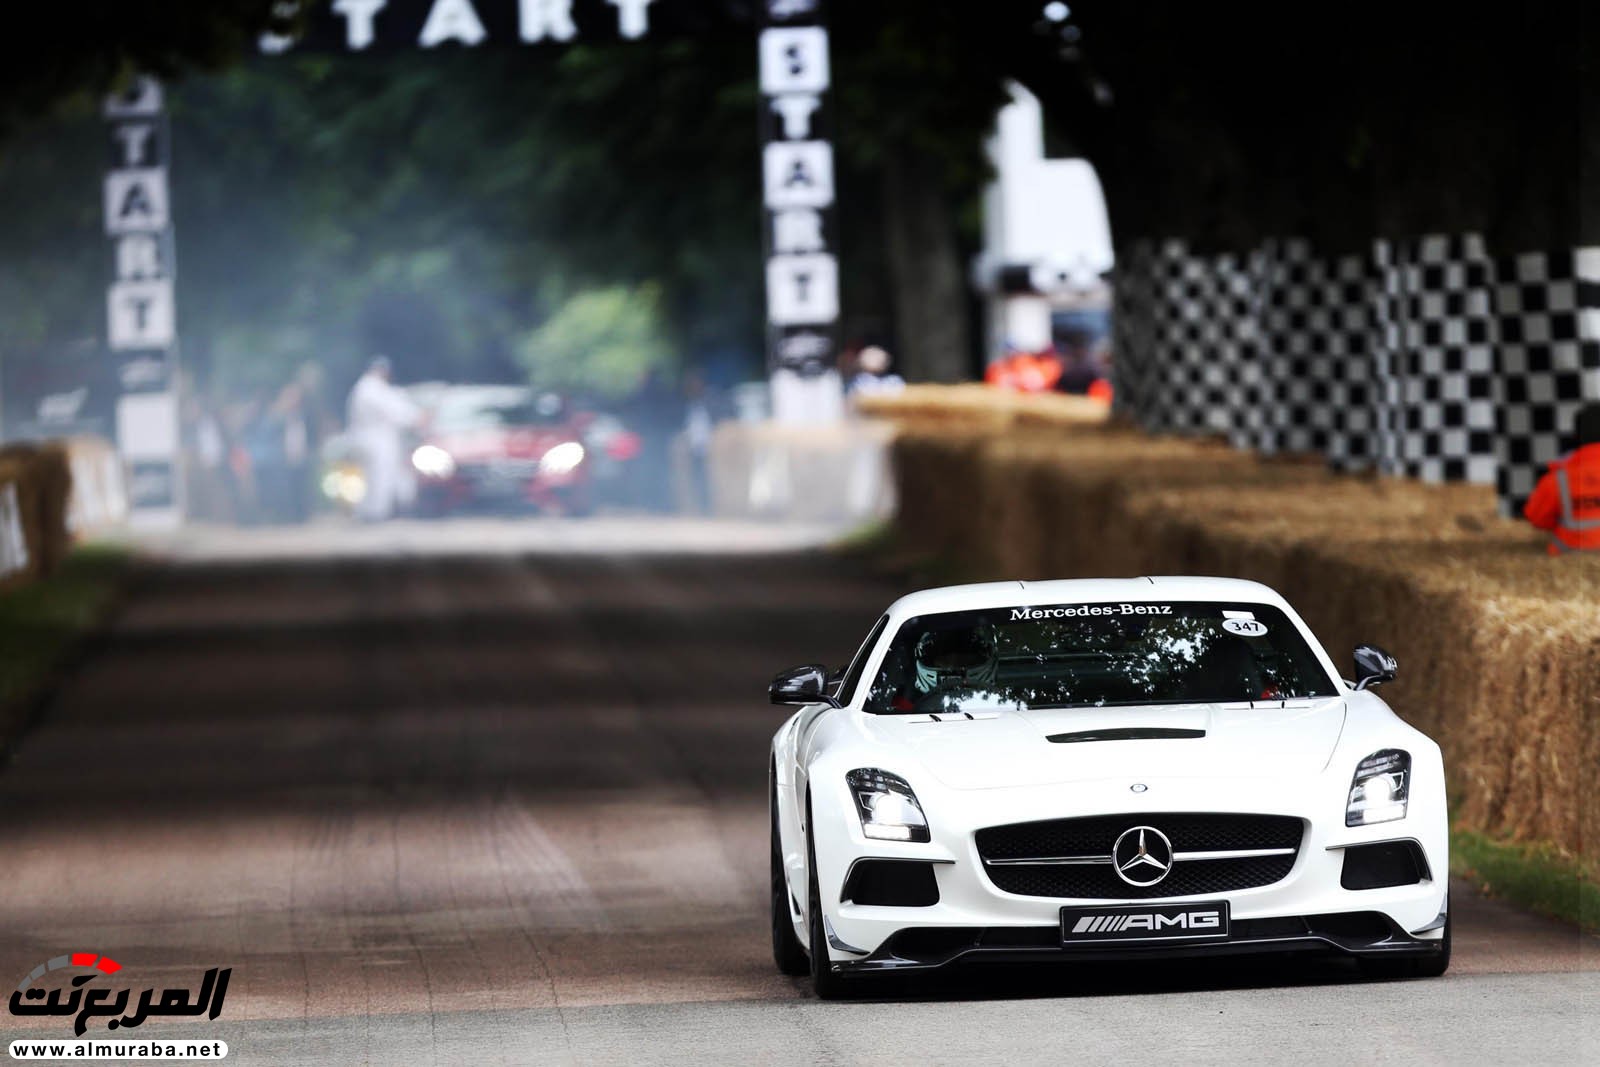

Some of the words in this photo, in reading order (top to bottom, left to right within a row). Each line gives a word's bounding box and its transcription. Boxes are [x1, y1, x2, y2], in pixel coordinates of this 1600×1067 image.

[1010, 604, 1173, 621] Mercedes-Benz
[1231, 620, 1261, 632] 347
[1119, 911, 1219, 931] AMG
